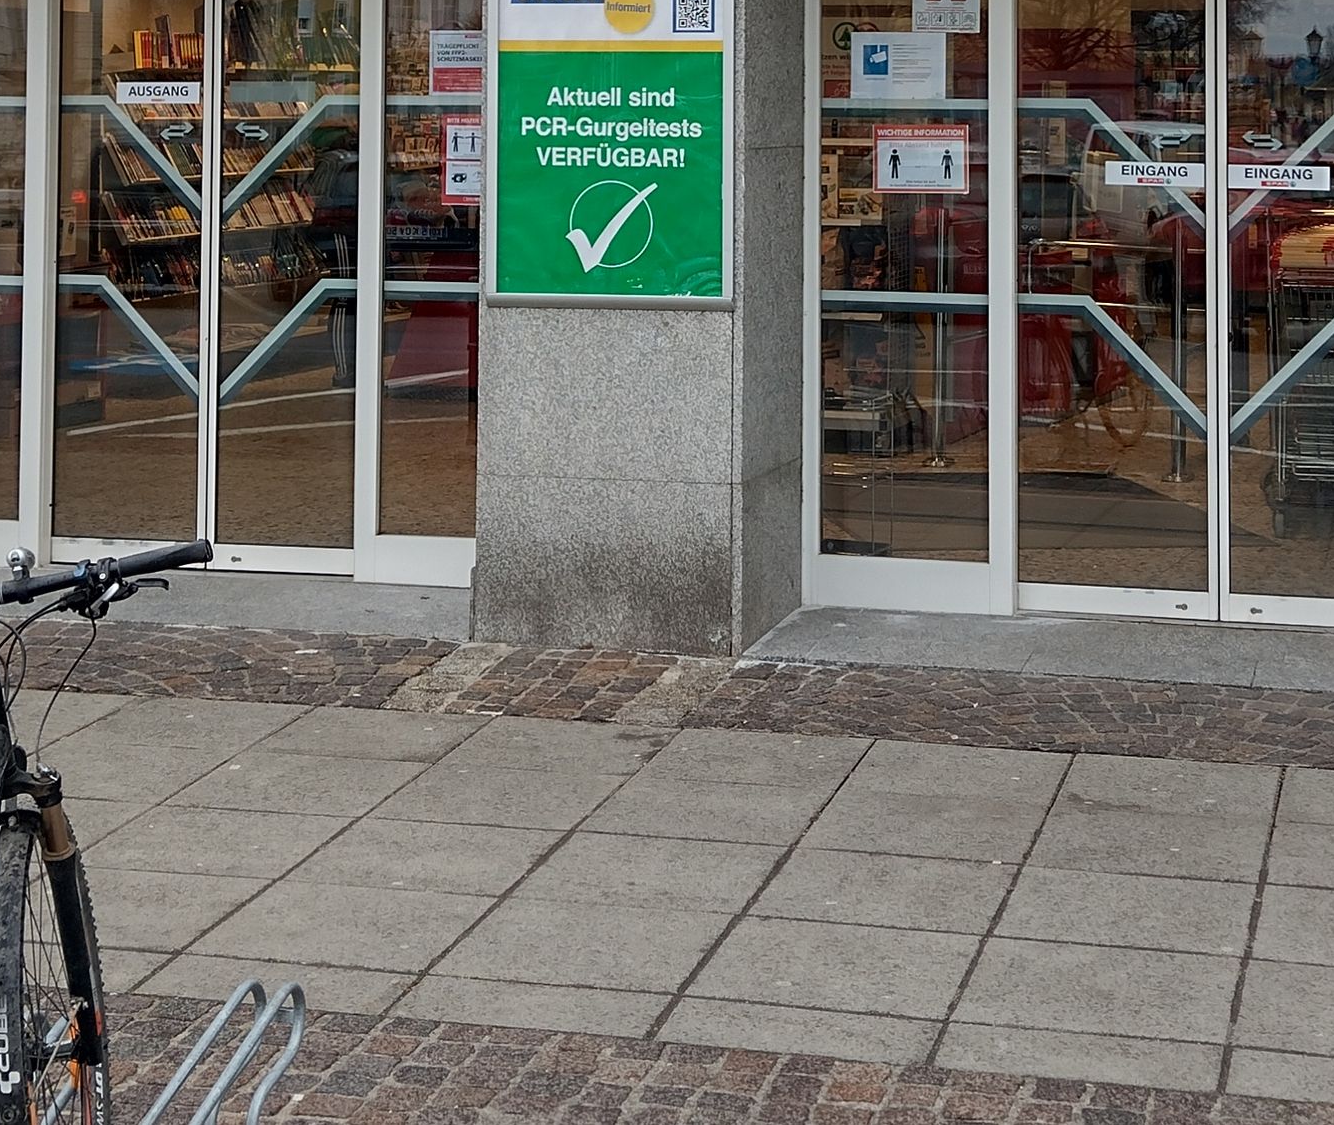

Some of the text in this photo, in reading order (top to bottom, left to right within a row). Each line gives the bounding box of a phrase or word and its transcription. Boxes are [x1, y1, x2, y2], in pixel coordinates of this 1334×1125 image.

[606, 2, 651, 14] Informiert
[128, 86, 189, 97] AUSGANG
[547, 87, 676, 108] Aktuell sind
[521, 118, 703, 140] PCR-Gurgeltests
[877, 128, 964, 136] WICHTIGE INFORMATION
[536, 143, 686, 169] VERFÜGBAR!
[1121, 164, 1189, 177] EINGANG
[1244, 167, 1313, 180] EINGANG
[95, 1071, 105, 1099] DT
